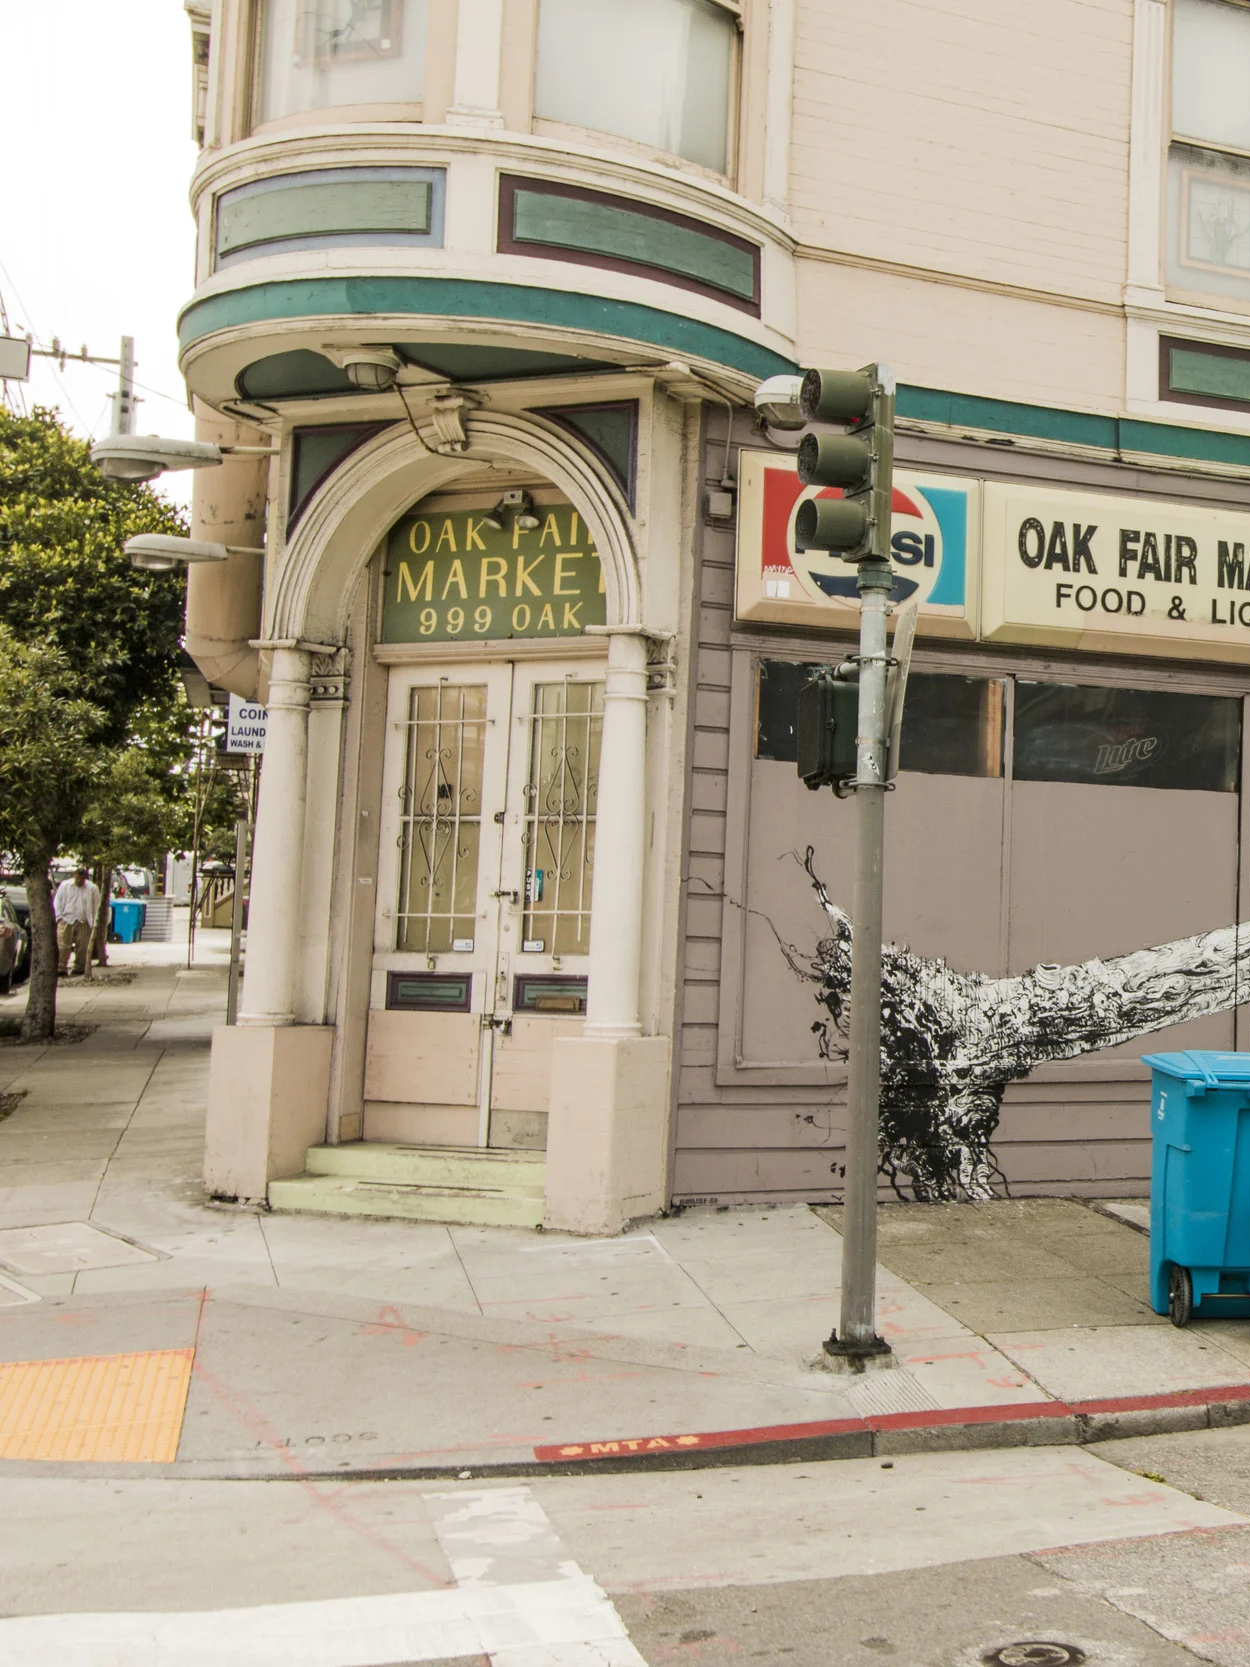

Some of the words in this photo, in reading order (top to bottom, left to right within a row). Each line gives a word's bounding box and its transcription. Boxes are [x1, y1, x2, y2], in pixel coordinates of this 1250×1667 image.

[409, 517, 487, 554] OAK
[512, 512, 594, 549] FAI
[1018, 516, 1099, 575] OAK
[1118, 528, 1198, 585] FAIR
[419, 605, 492, 635] 999
[511, 602, 583, 631] OAK
[1055, 583, 1146, 616] FOOD
[1167, 595, 1187, 621] &
[230, 740, 254, 748] WASH
[231, 726, 266, 737] LAUND
[590, 1437, 671, 1454] MTA
